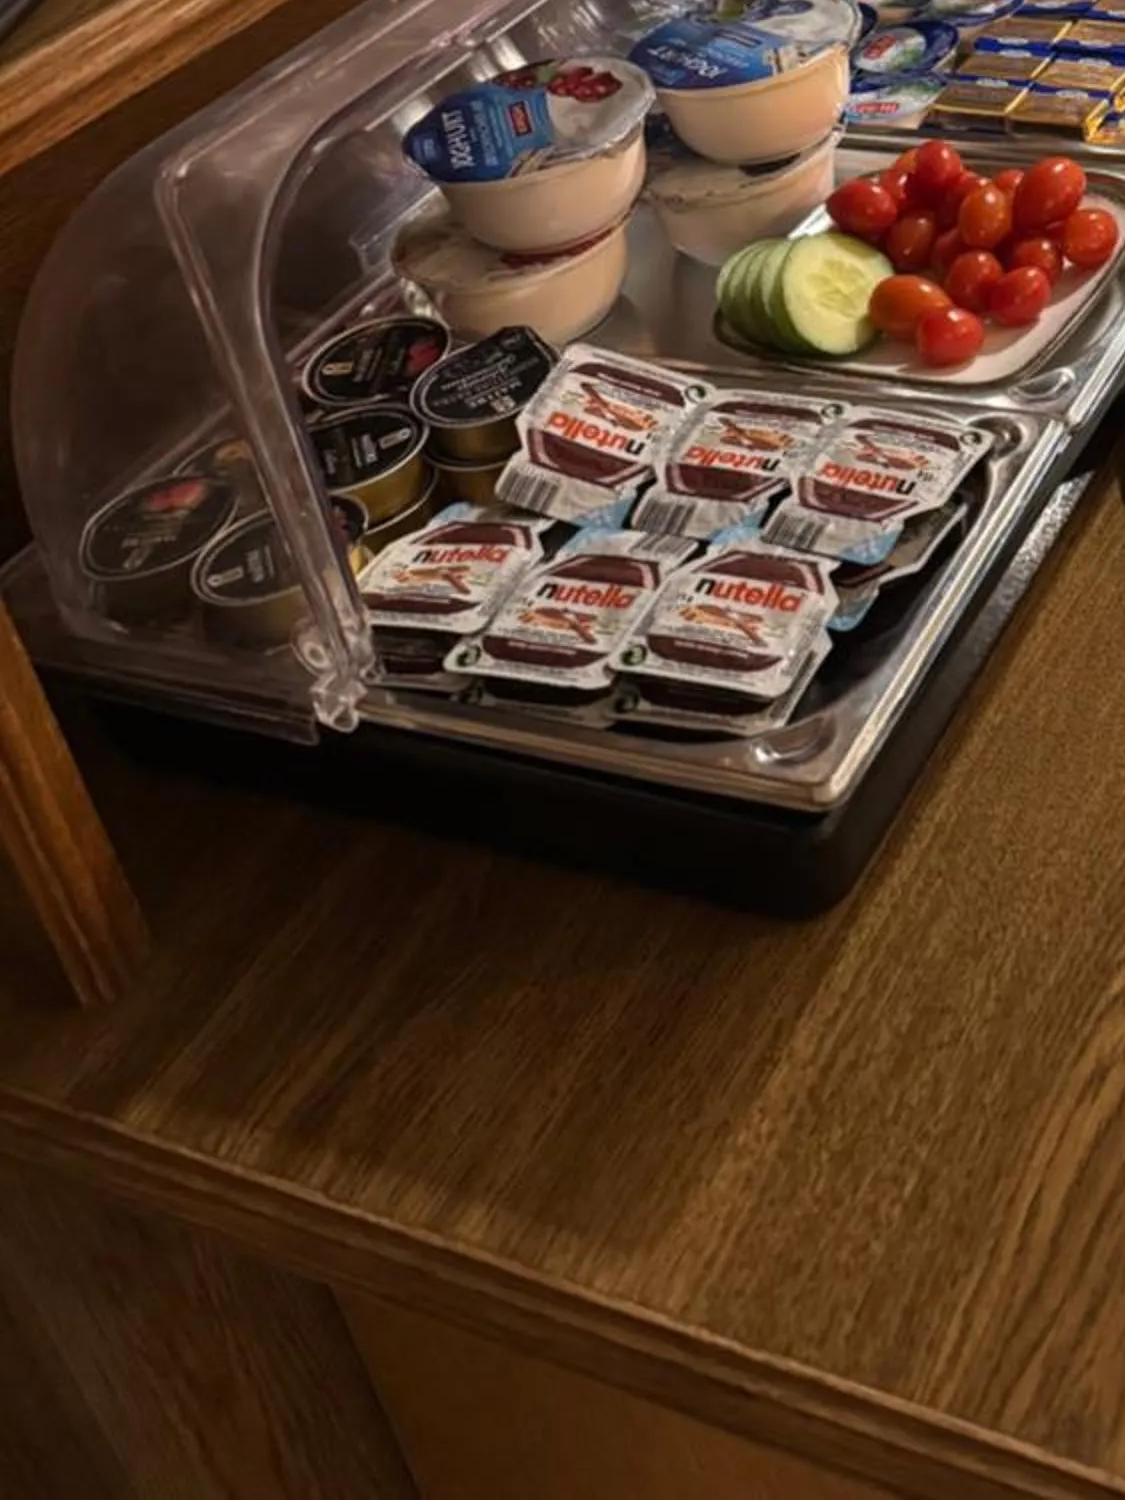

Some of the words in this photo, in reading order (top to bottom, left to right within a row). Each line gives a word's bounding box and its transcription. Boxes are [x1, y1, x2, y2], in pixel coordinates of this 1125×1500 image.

[546, 410, 645, 455] nutella
[682, 444, 781, 472] nutella
[820, 461, 917, 495] nutella
[411, 545, 508, 565] nutella
[536, 582, 636, 609] nutella
[694, 577, 803, 613] nutella
